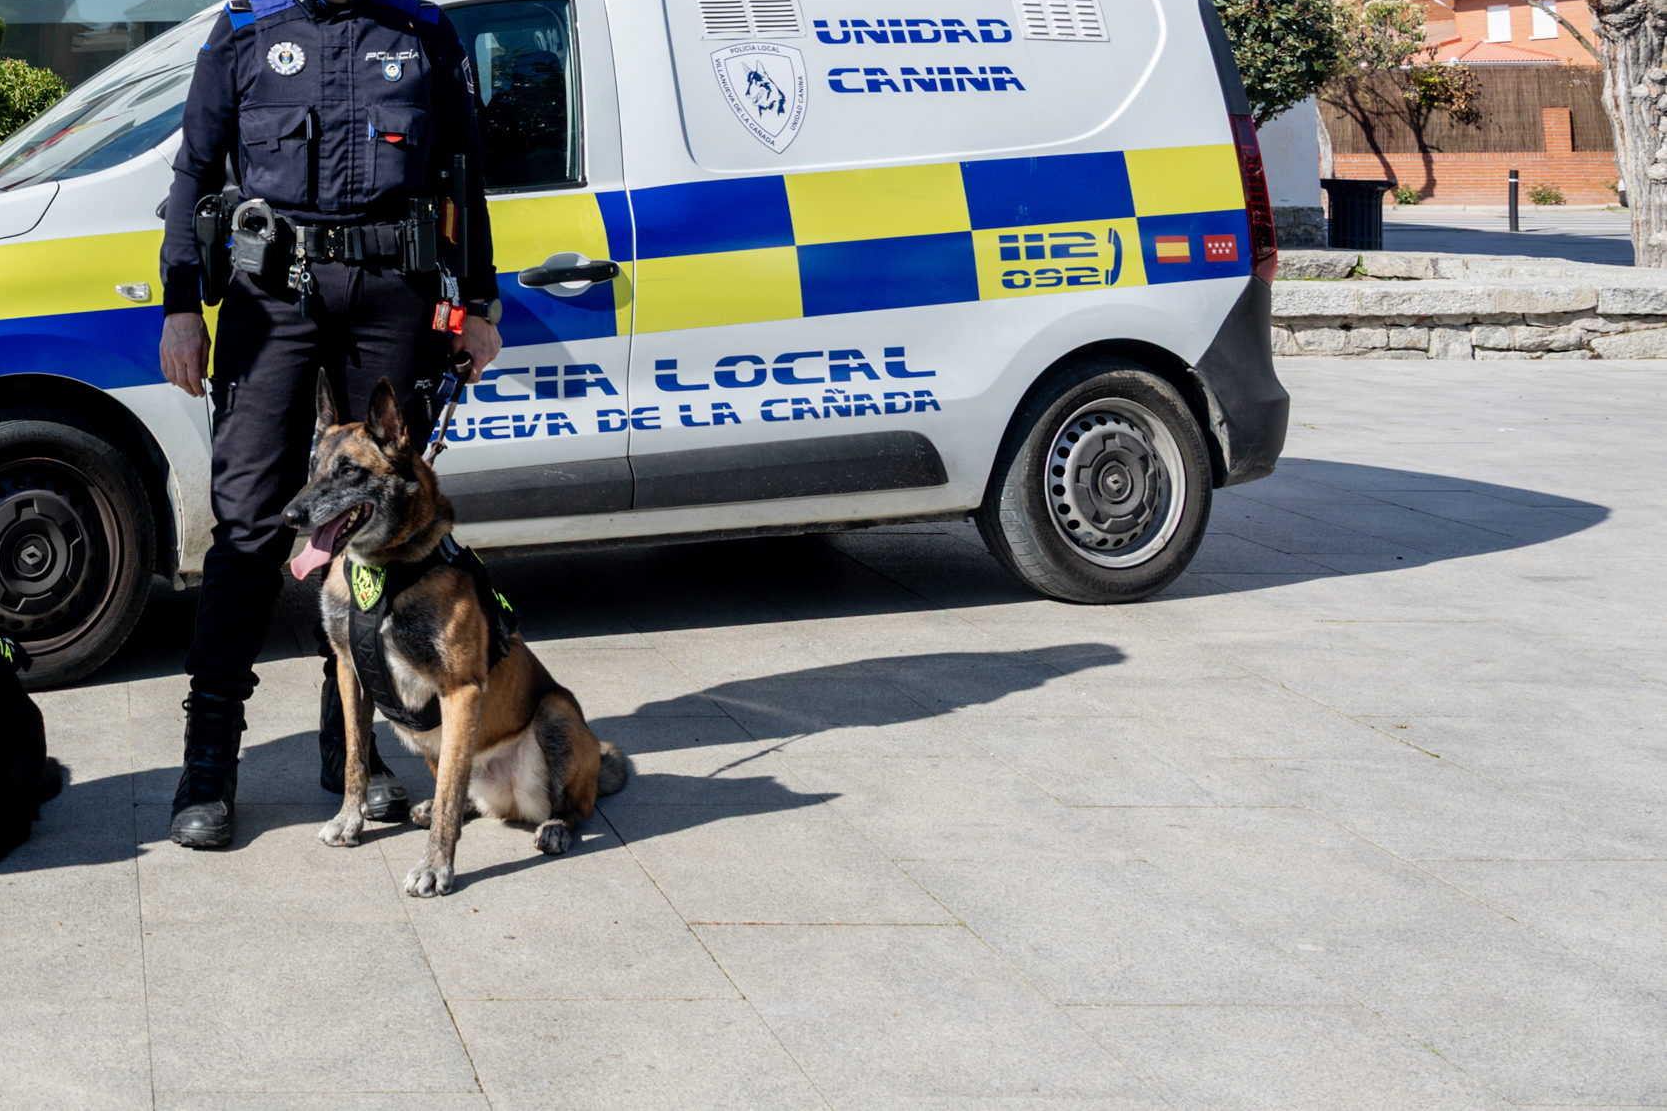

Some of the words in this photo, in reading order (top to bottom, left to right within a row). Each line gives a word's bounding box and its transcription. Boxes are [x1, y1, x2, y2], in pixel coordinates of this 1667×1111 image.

[812, 18, 1013, 44] UNIDAD
[729, 44, 756, 54] POLICÍA
[757, 45, 780, 53] LOCAL
[827, 66, 1027, 93] CANINA
[714, 58, 735, 103] VILLANUEVA
[733, 102, 743, 113] DE
[740, 113, 750, 124] LA
[748, 122, 776, 147] CAÑADA
[789, 104, 803, 131] UNIDAD
[998, 231, 1099, 261] 112
[1001, 266, 1102, 289] 092
[654, 346, 937, 392] LOCAL
[596, 406, 662, 433] DE
[679, 401, 742, 427] LA
[760, 388, 942, 422] CAÑADA
